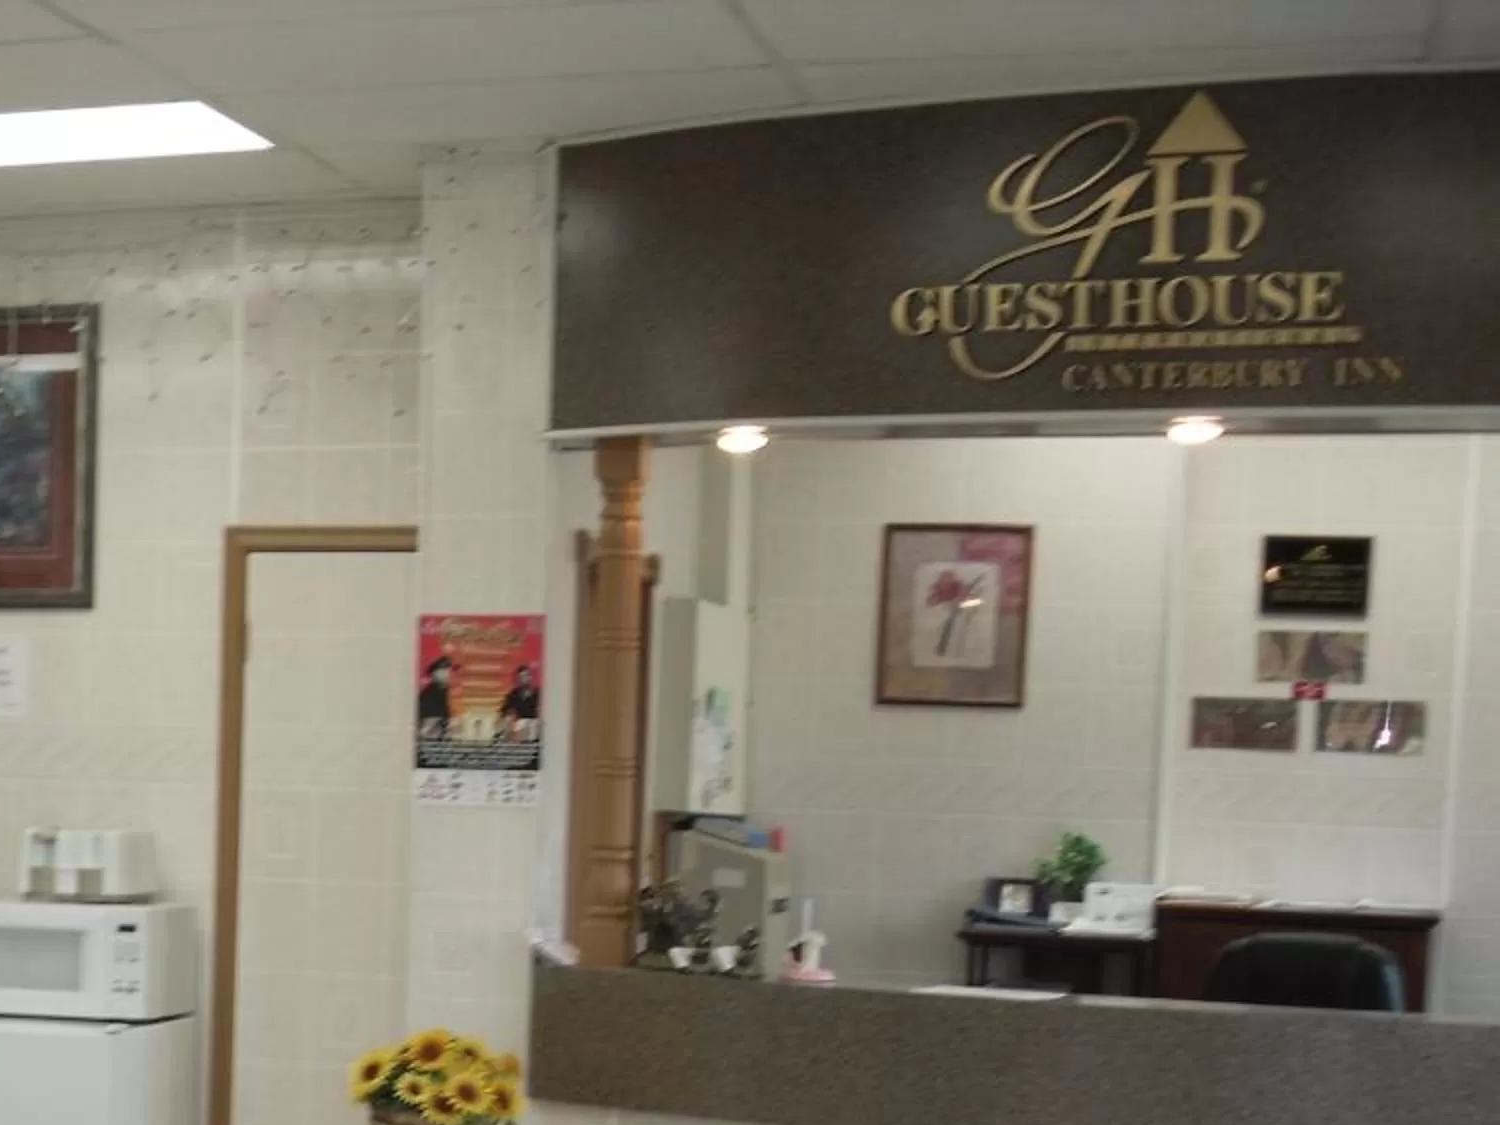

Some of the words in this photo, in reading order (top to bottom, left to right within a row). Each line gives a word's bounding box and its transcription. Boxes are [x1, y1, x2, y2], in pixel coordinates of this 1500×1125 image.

[890, 271, 1346, 338] GUESTHOUSE
[1061, 359, 1310, 392] CANTERBURY
[1332, 356, 1404, 387] INN
